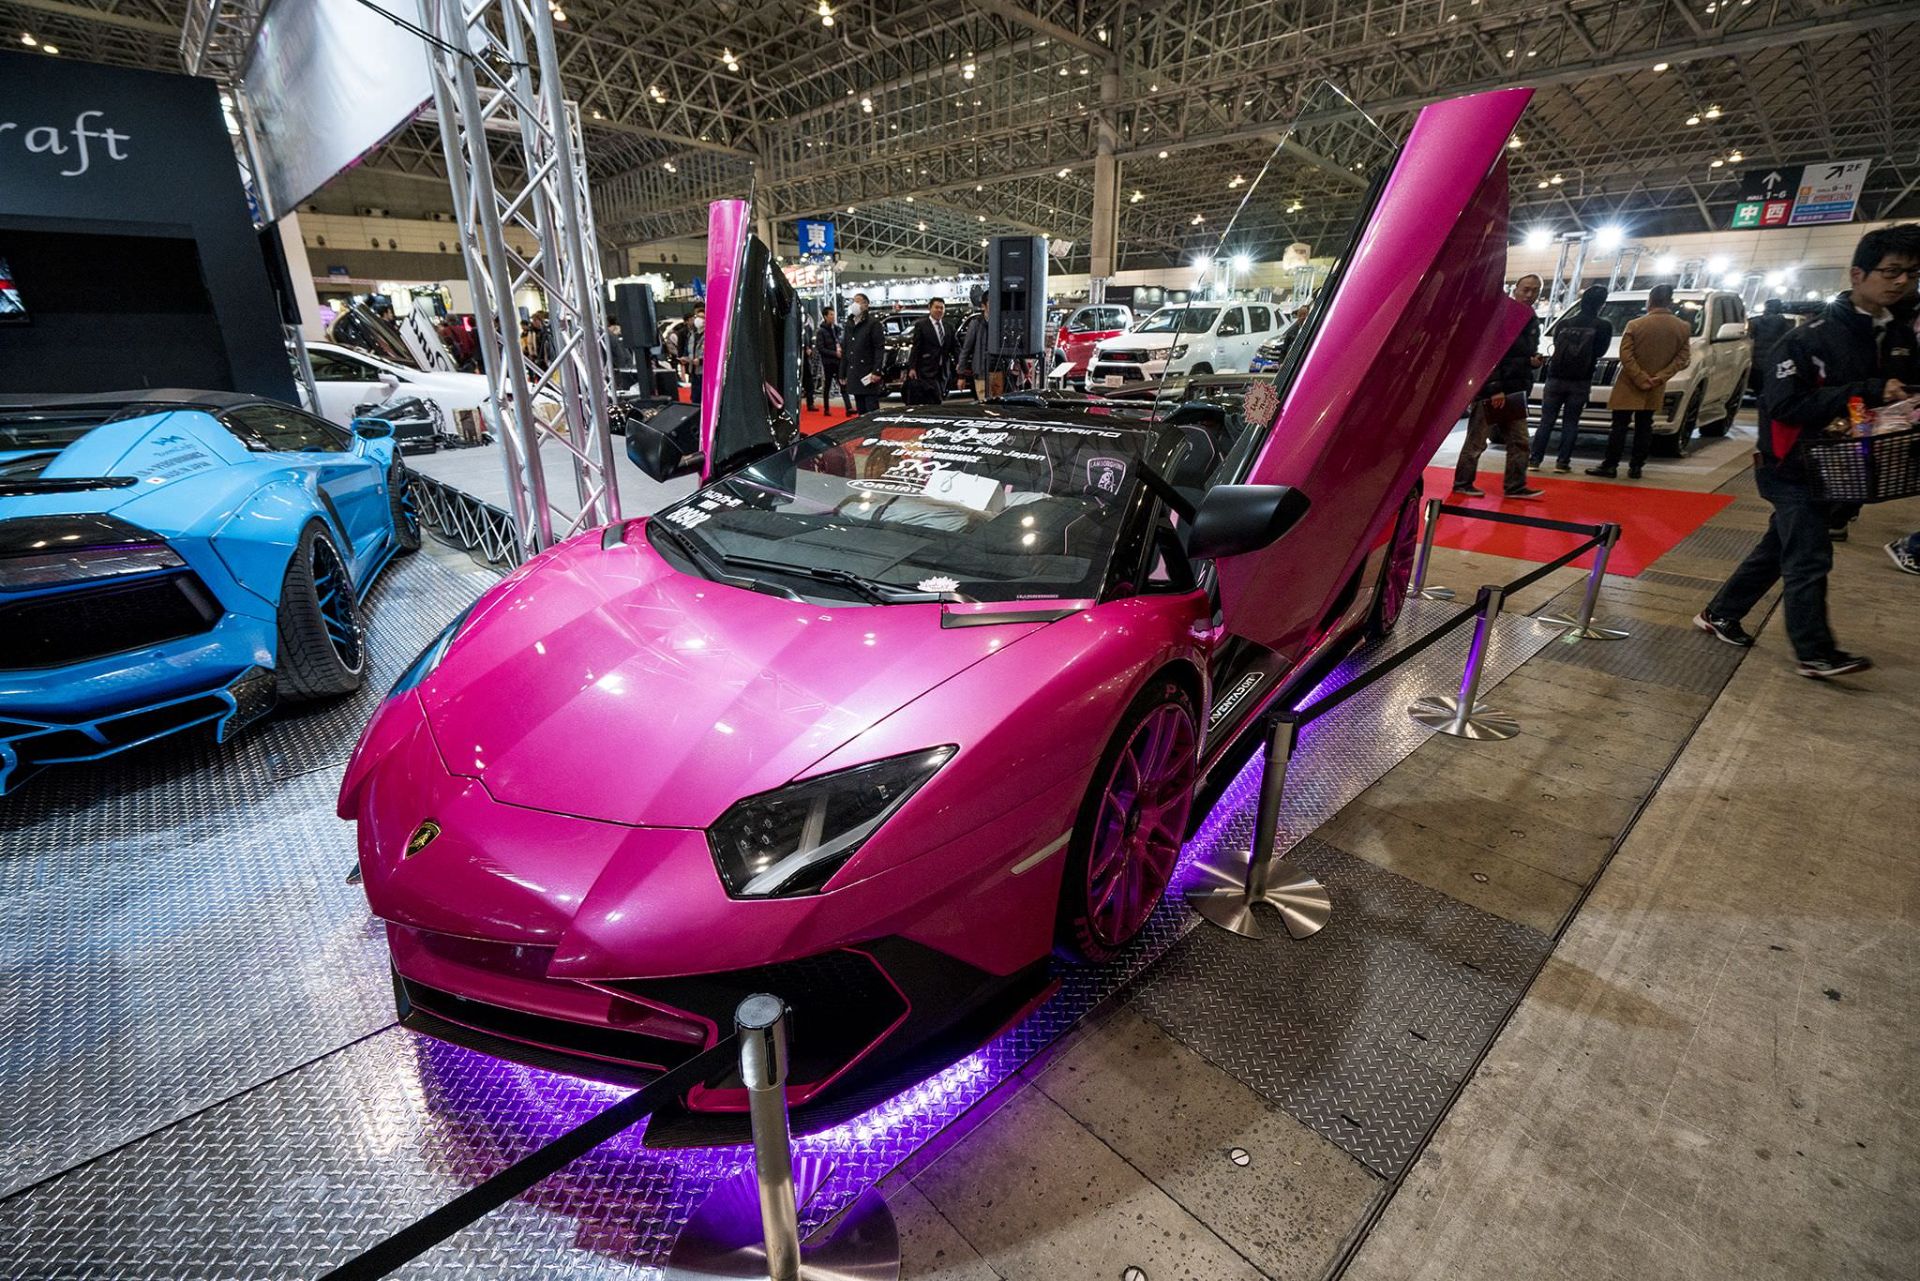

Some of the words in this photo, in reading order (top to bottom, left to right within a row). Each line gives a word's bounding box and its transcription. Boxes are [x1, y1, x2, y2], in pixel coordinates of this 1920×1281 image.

[1845, 163, 1863, 172] 2F
[1739, 204, 1759, 221] 中
[1766, 202, 1788, 219] 西
[806, 223, 827, 248] 東
[953, 418, 1006, 429] 029
[913, 441, 973, 453] Protection
[974, 445, 1002, 456] Film
[1003, 450, 1046, 461] Japan
[1210, 676, 1256, 723] AVENTADOR
